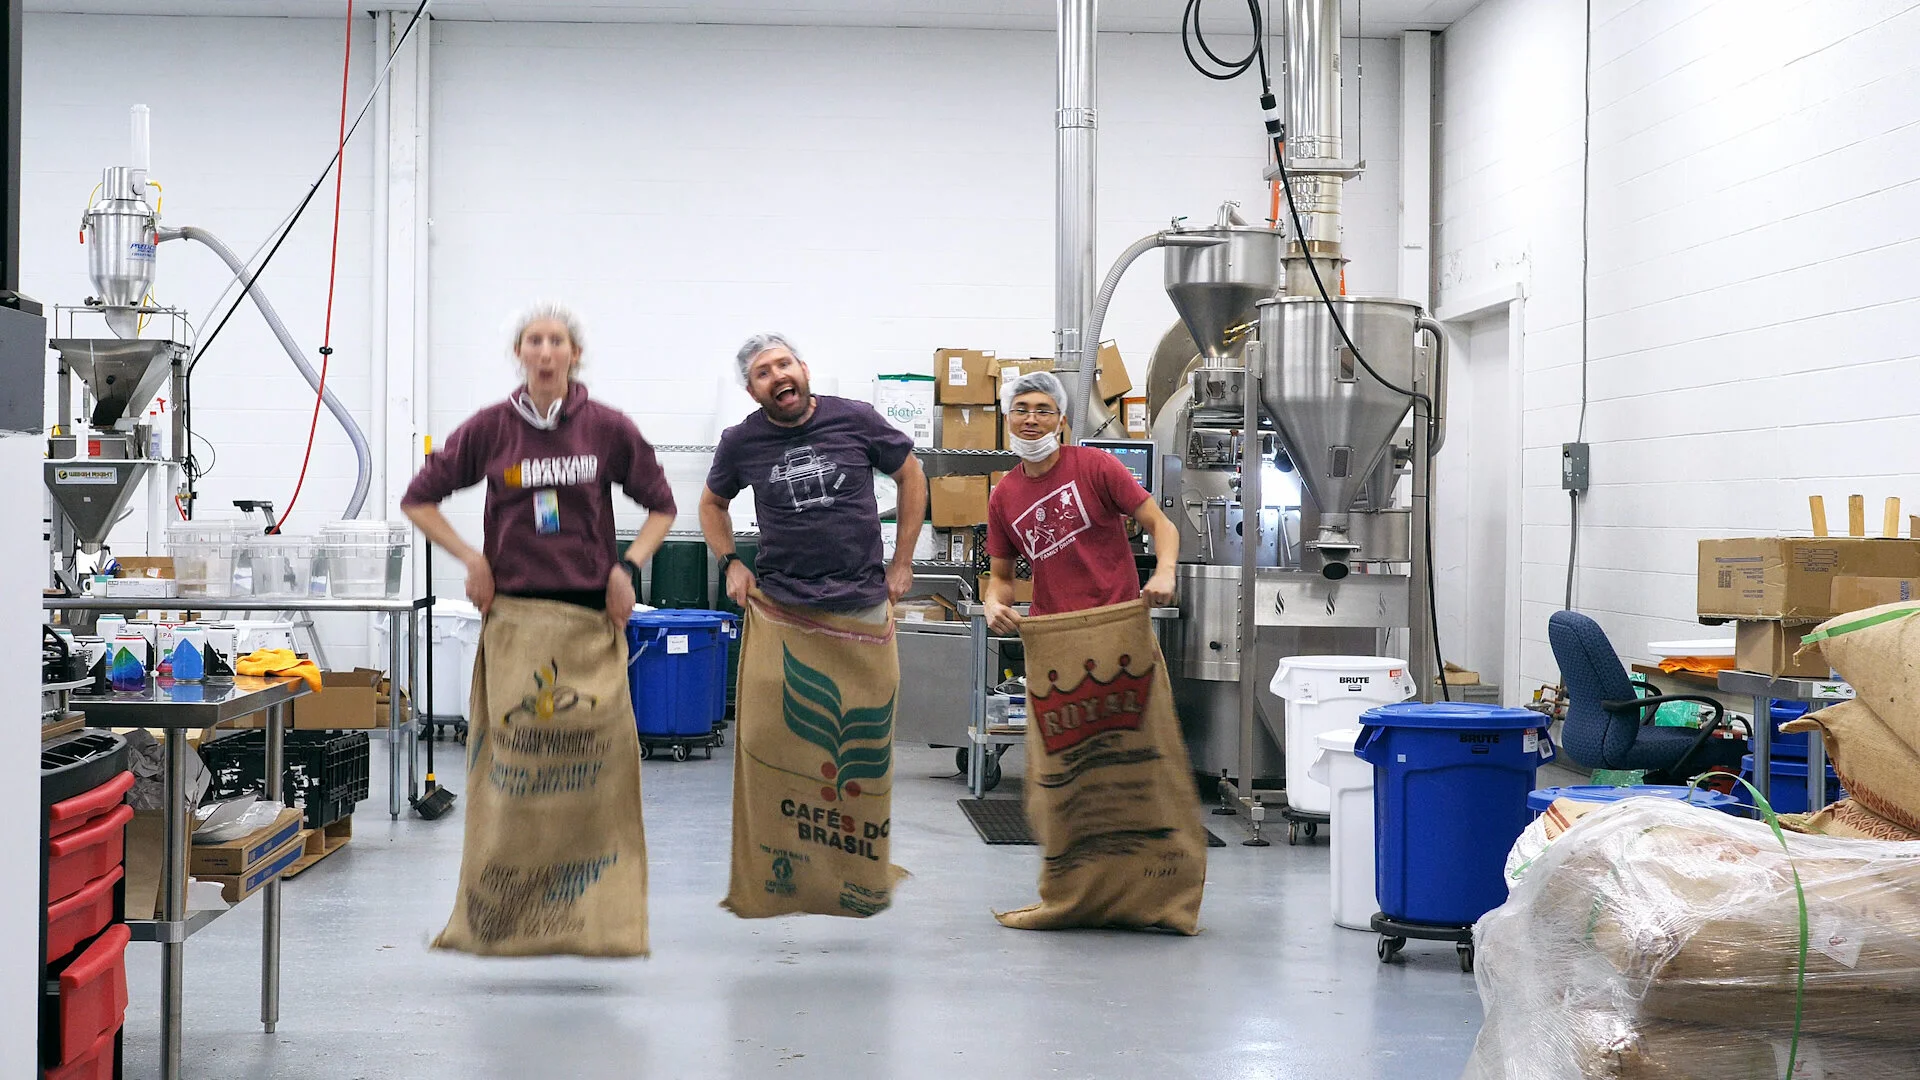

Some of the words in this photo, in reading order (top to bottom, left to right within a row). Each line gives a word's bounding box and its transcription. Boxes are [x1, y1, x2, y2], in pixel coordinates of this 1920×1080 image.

[1044, 689, 1141, 736] ROYAL
[1460, 734, 1499, 743] BRUTE
[781, 799, 855, 833] CAFÉS
[798, 822, 879, 861] BRASIL
